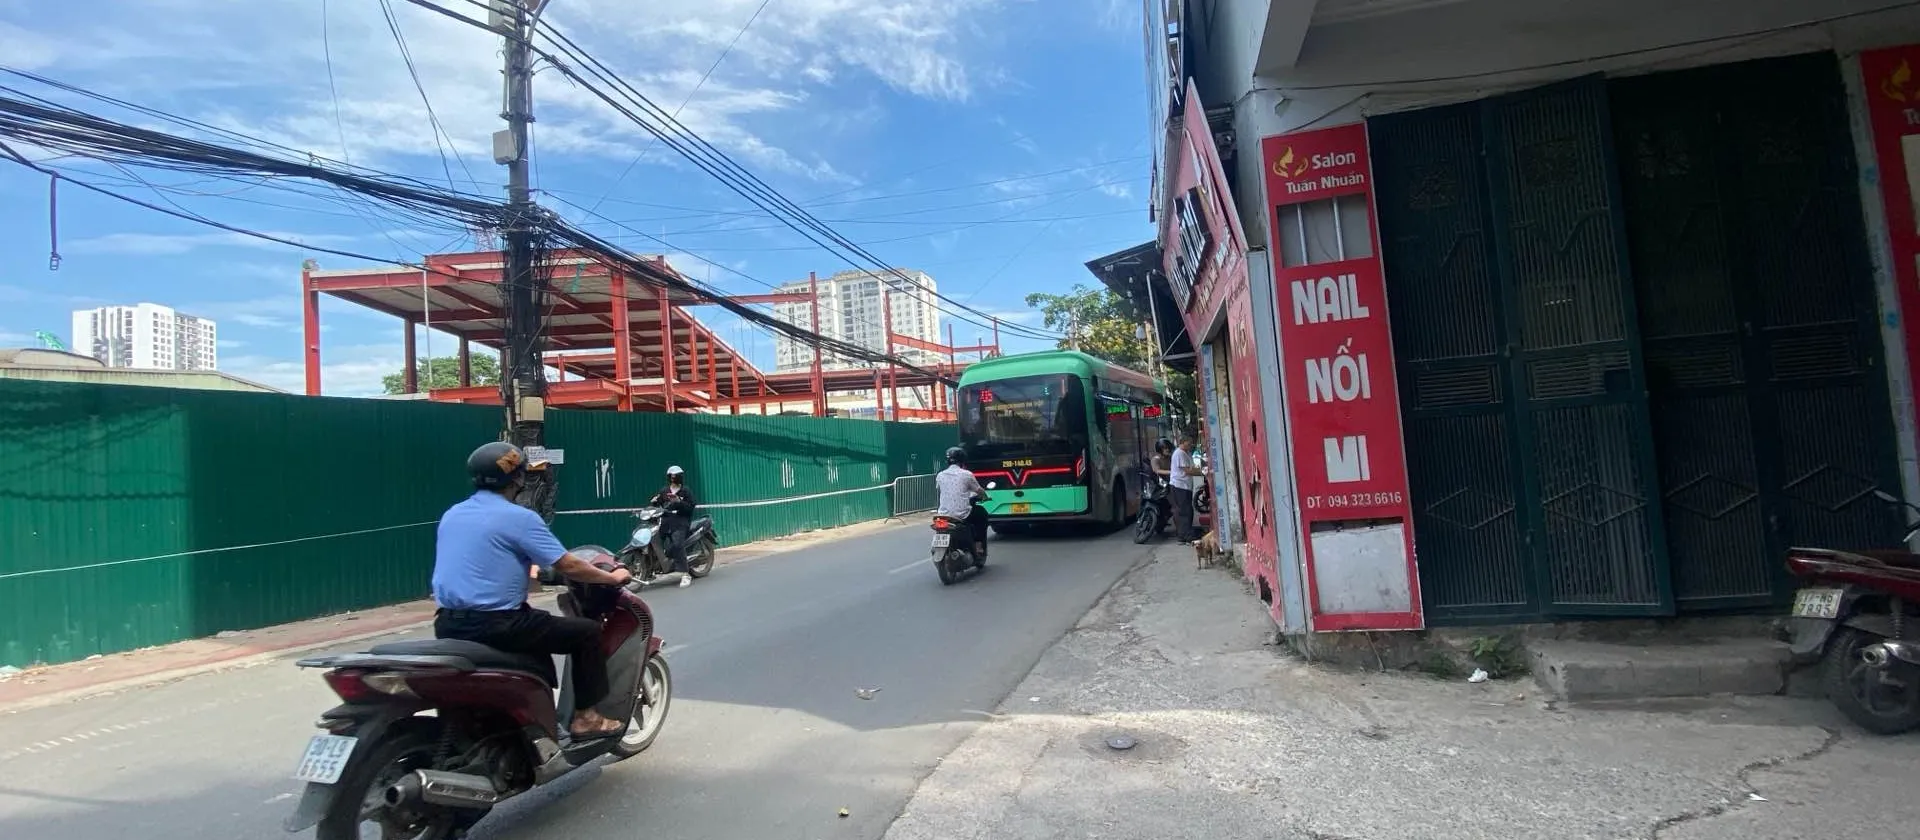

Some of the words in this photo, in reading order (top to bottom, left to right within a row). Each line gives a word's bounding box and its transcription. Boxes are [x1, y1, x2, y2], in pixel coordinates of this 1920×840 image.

[1312, 152, 1356, 169] Salon
[1291, 274, 1370, 326] NAIL
[1305, 337, 1371, 403] NỐI
[1324, 435, 1370, 483] MI
[1328, 495, 1348, 508] 094
[1374, 491, 1402, 505] 6616
